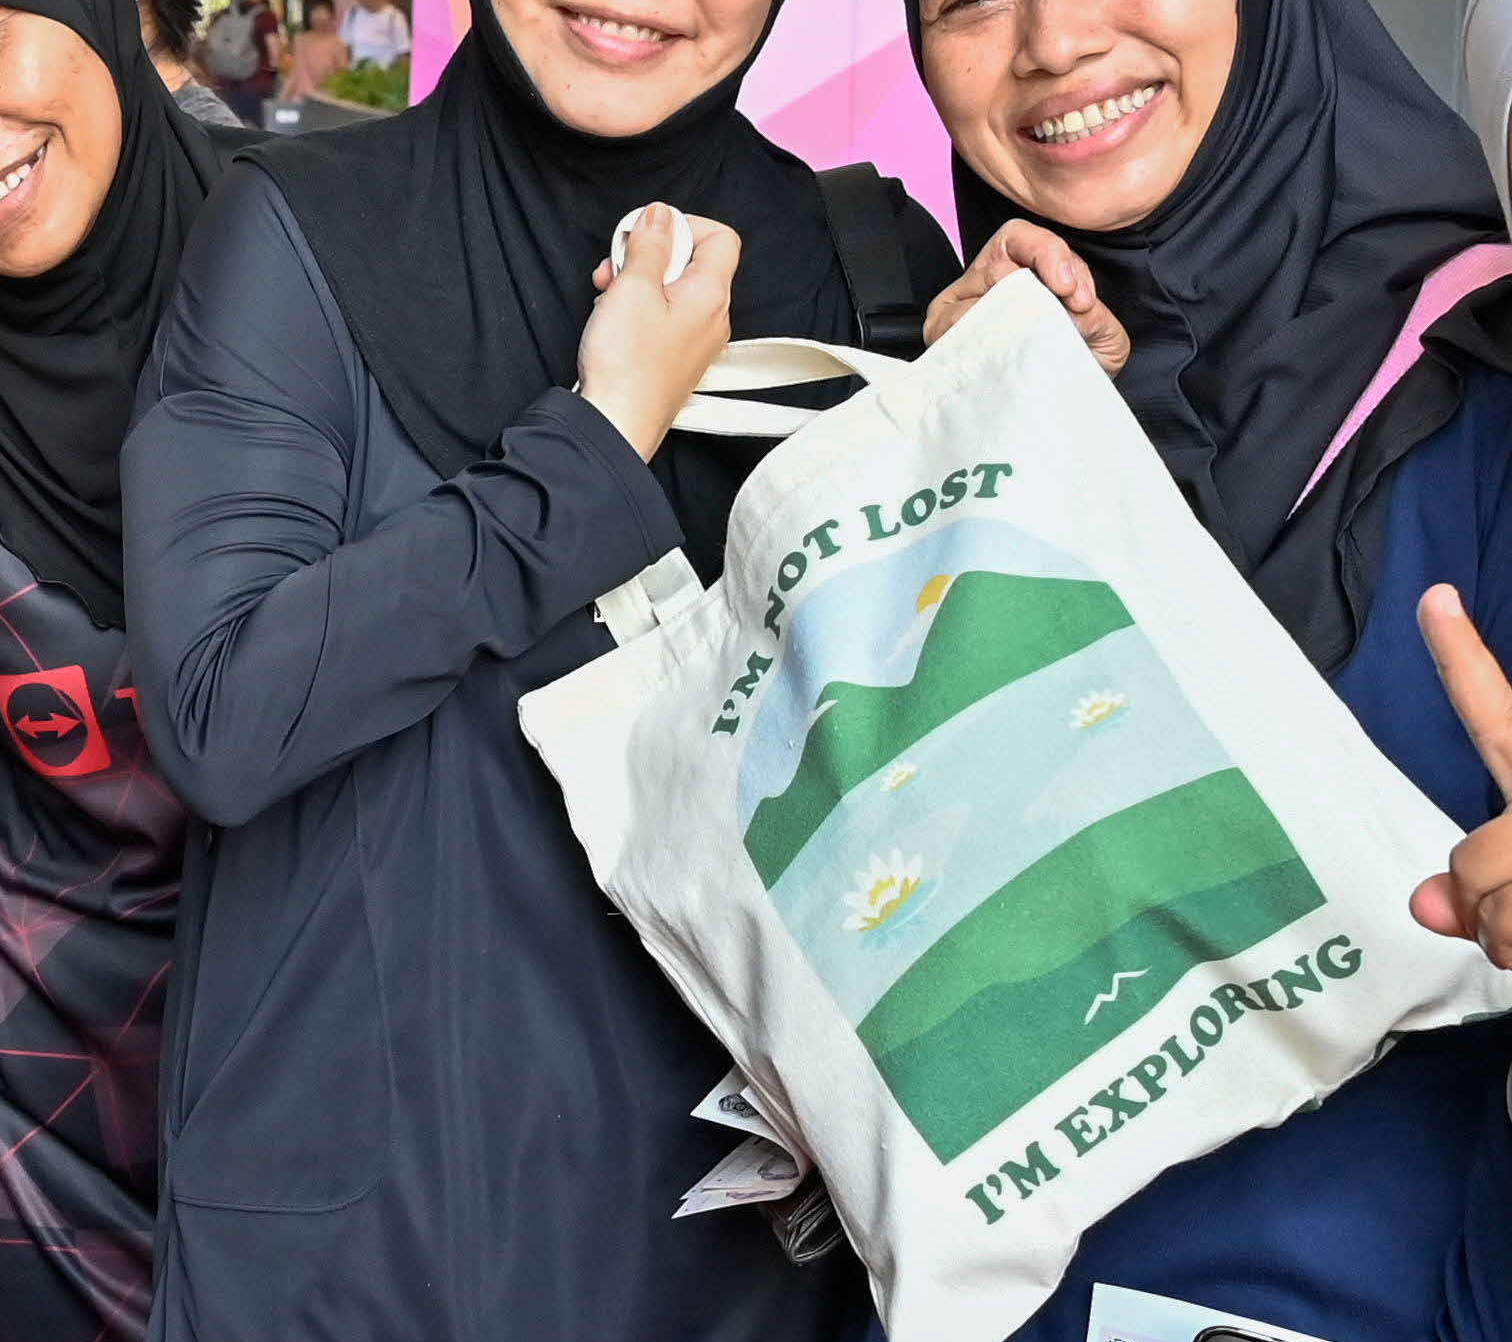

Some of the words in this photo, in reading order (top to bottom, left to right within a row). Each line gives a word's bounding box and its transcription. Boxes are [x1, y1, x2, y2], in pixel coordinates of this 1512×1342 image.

[711, 649, 777, 737] I'M
[763, 520, 842, 637] NOT
[860, 461, 1015, 542] LOST
[963, 1149, 1062, 1226] I'M
[1062, 934, 1367, 1157] EXPLORING
